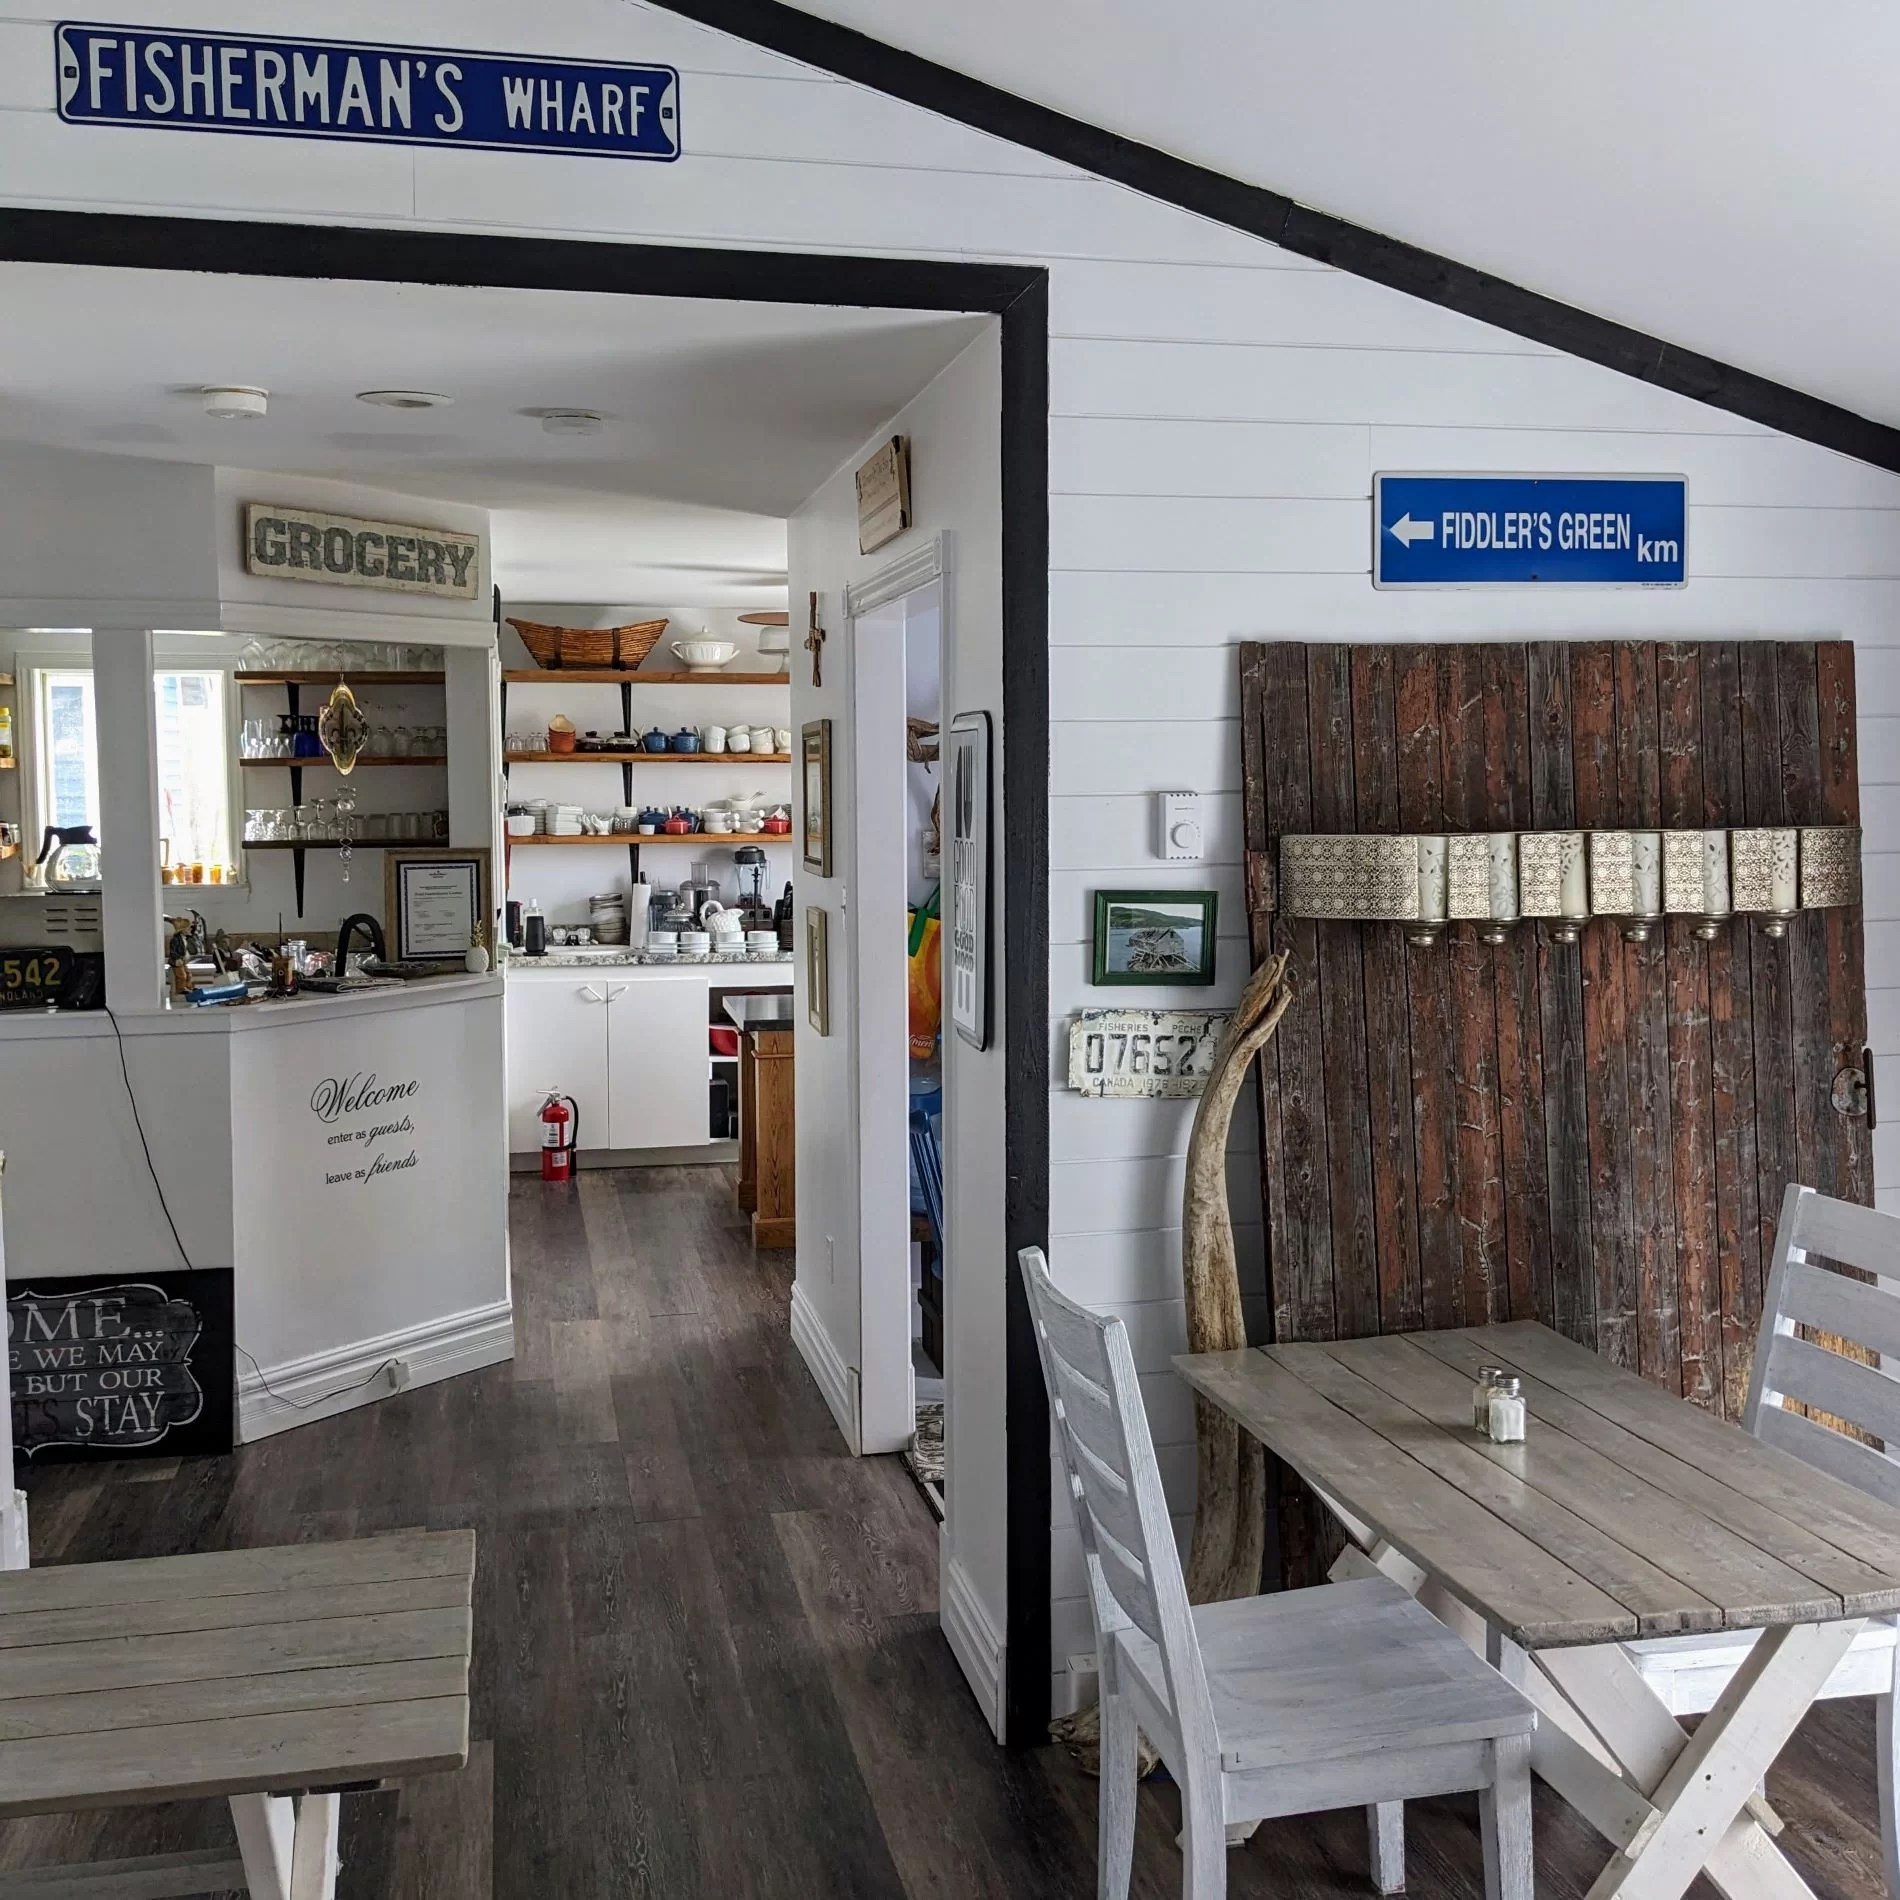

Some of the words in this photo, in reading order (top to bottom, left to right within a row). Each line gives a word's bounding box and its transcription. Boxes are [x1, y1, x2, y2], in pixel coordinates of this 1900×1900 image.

[88, 37, 465, 133] FISHERMAN'S
[502, 76, 650, 138] WHARF
[254, 516, 475, 588] GROCERY
[1441, 511, 1552, 550] FIDDLER'S
[1558, 512, 1631, 550] GREEN
[1636, 533, 1679, 563] km
[953, 839, 974, 887] GOOD
[954, 929, 974, 954] GOOD
[3, 957, 62, 990] 542
[1099, 1021, 1149, 1033] FISHERIES
[310, 1071, 421, 1124] Welcome
[1092, 1076, 1135, 1088] CANADA
[327, 1131, 353, 1146] enter
[355, 1129, 367, 1140] as
[364, 1114, 416, 1148] guests,
[325, 1172, 353, 1185] leave
[354, 1167, 366, 1178] as
[363, 1149, 421, 1185] friends
[32, 1346, 87, 1369] WE
[96, 1340, 164, 1365] MAY
[25, 1373, 88, 1395] BUT
[99, 1368, 165, 1390] OUR
[75, 1390, 166, 1437] STAY
